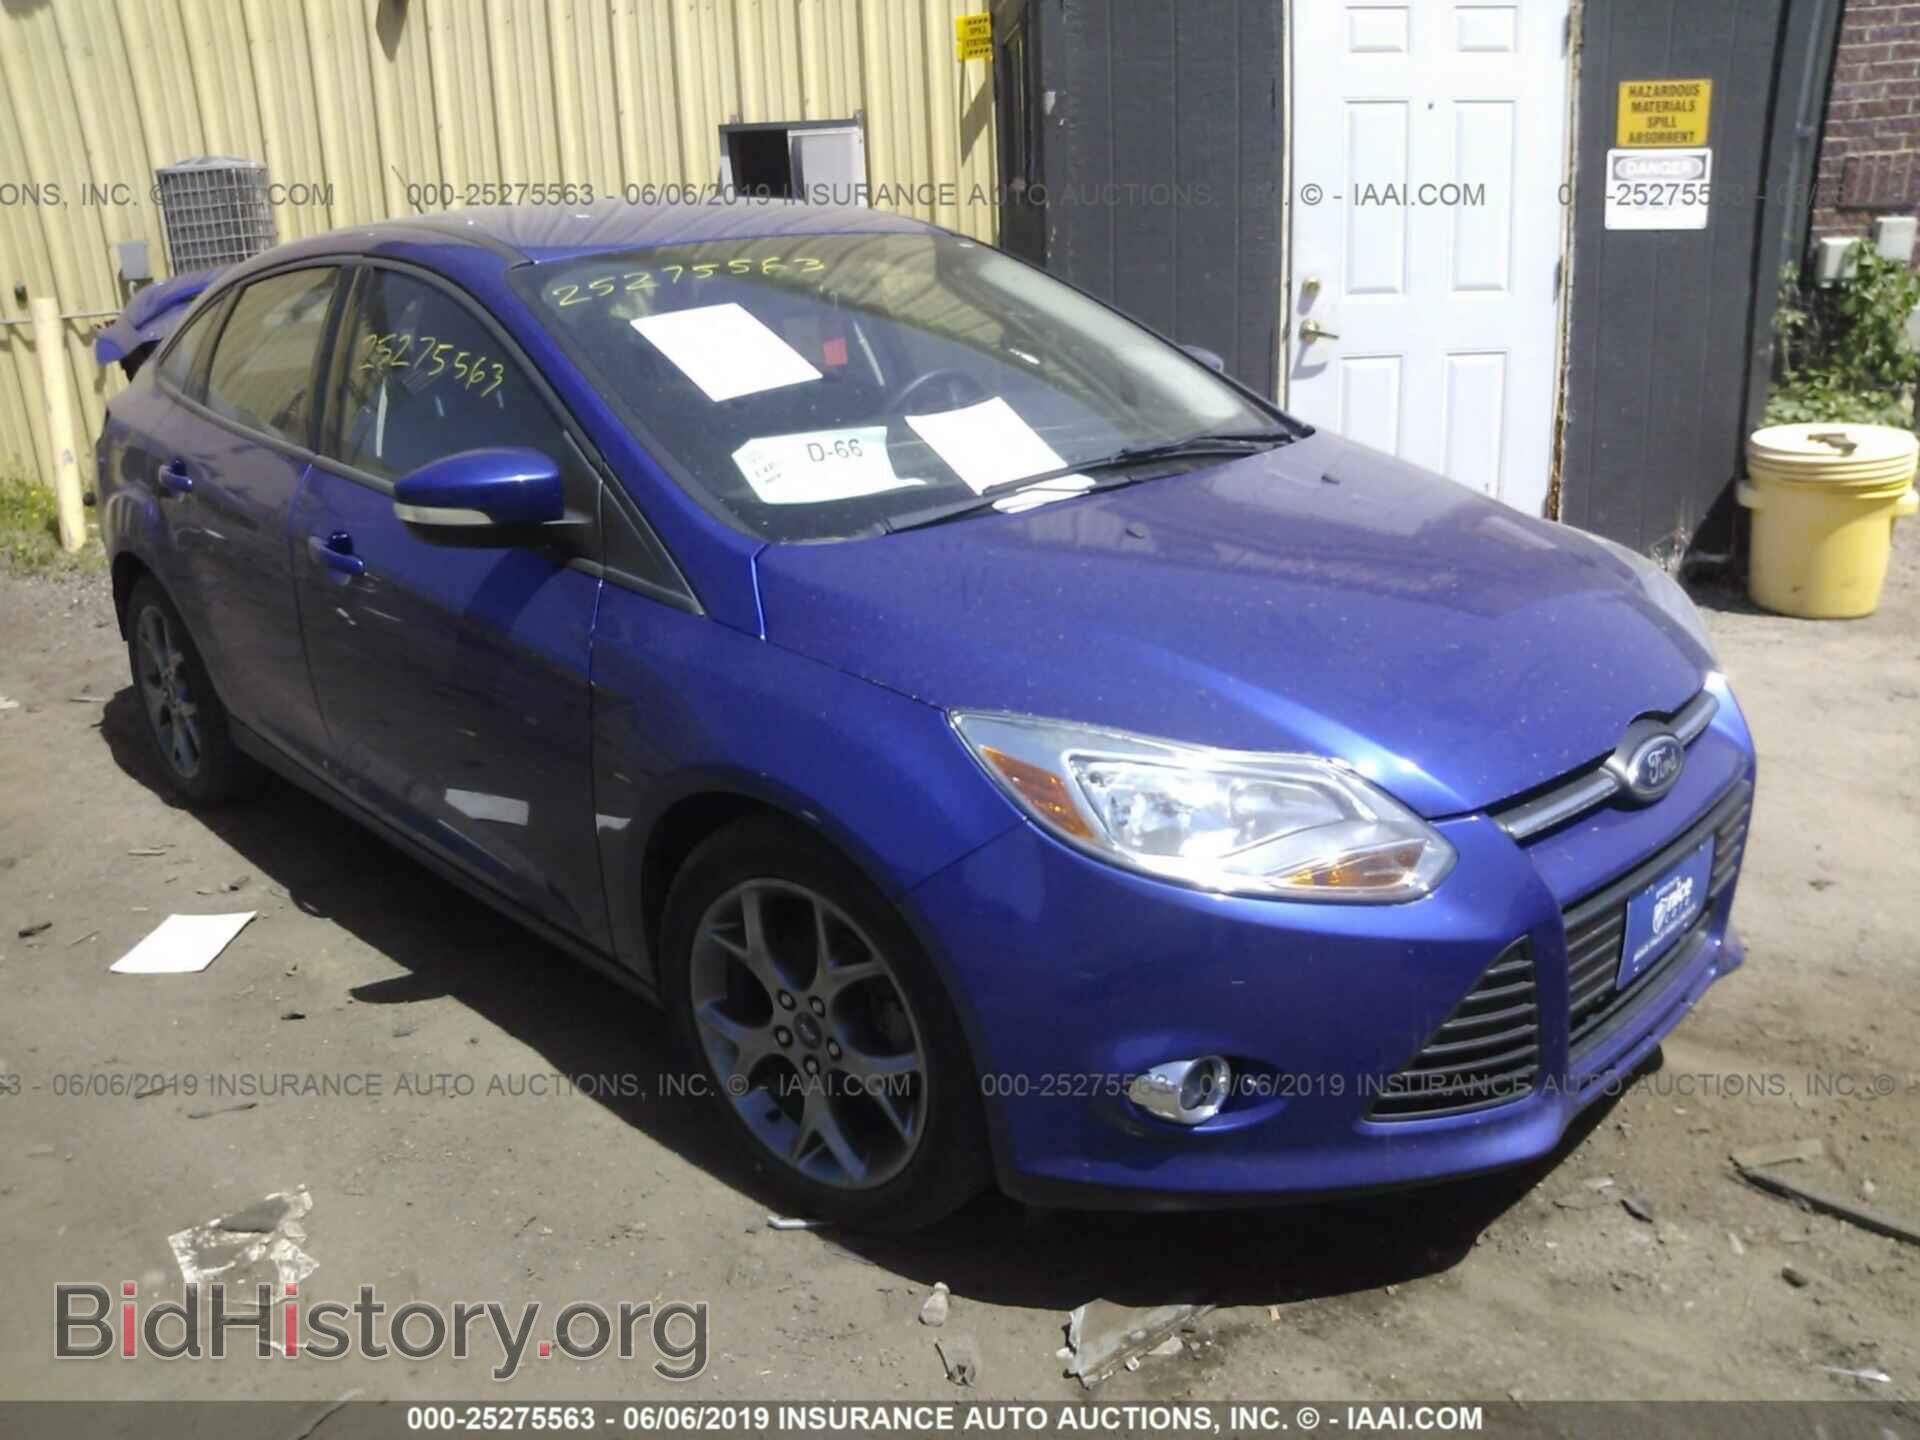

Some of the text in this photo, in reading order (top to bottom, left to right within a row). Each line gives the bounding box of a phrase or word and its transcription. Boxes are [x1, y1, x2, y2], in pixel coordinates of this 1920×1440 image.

[1629, 84, 1700, 97] HAZARDOUS
[1631, 100, 1696, 113] MATERIALS
[1647, 116, 1677, 129] SPILL
[1629, 131, 1695, 144] ABSORBENT
[552, 256, 826, 306] 25275563
[359, 333, 505, 398] 25275563
[807, 438, 864, 463] D-66
[1647, 747, 1678, 785] Ford
